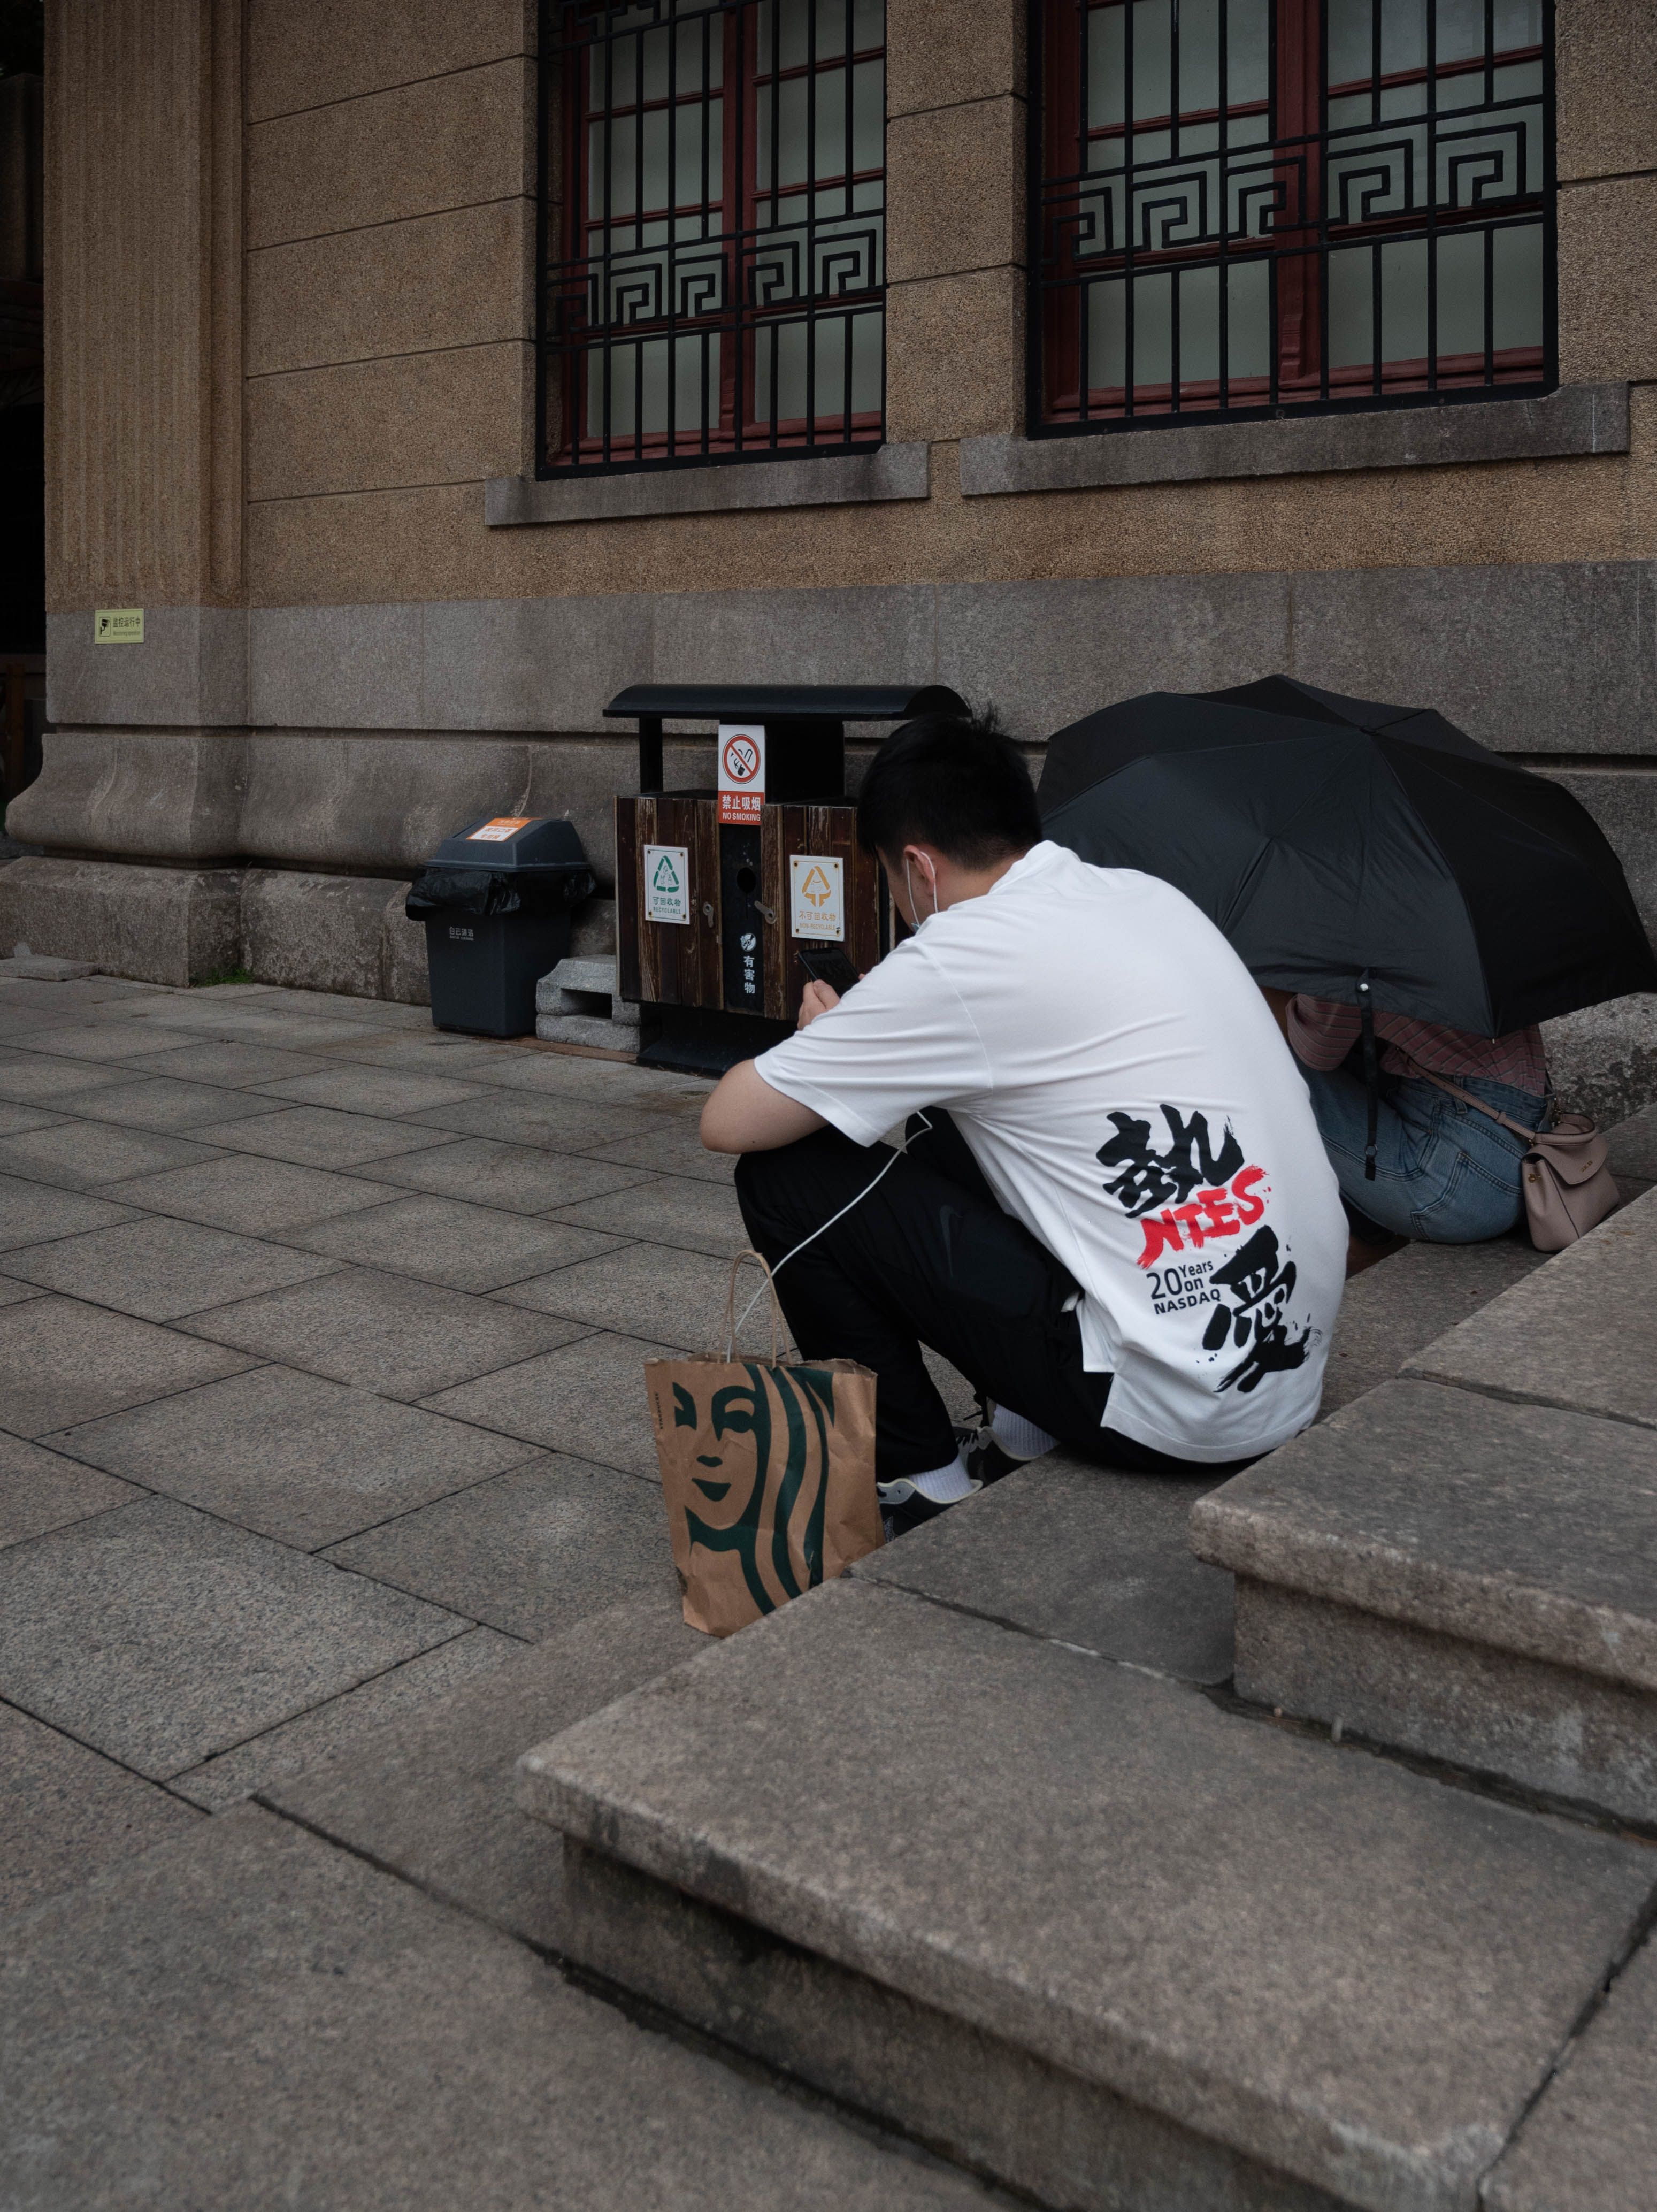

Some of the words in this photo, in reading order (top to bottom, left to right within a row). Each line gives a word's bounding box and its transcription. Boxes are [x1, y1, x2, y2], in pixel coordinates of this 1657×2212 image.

[113, 616, 141, 627] 监控运行中
[722, 794, 761, 811] 禁止吸烟
[732, 813, 761, 822] SMOKING
[653, 896, 681, 907] 可回收物
[653, 907, 681, 915] RECYCLABLE
[798, 910, 837, 922] 不可回收物
[743, 955, 756, 994] 有害物
[1137, 1164, 1269, 1270] NTES
[1146, 1268, 1183, 1300] 20
[1178, 1260, 1214, 1278] Years
[1184, 1277, 1204, 1292] on
[1154, 1288, 1221, 1315] NASDAQ
